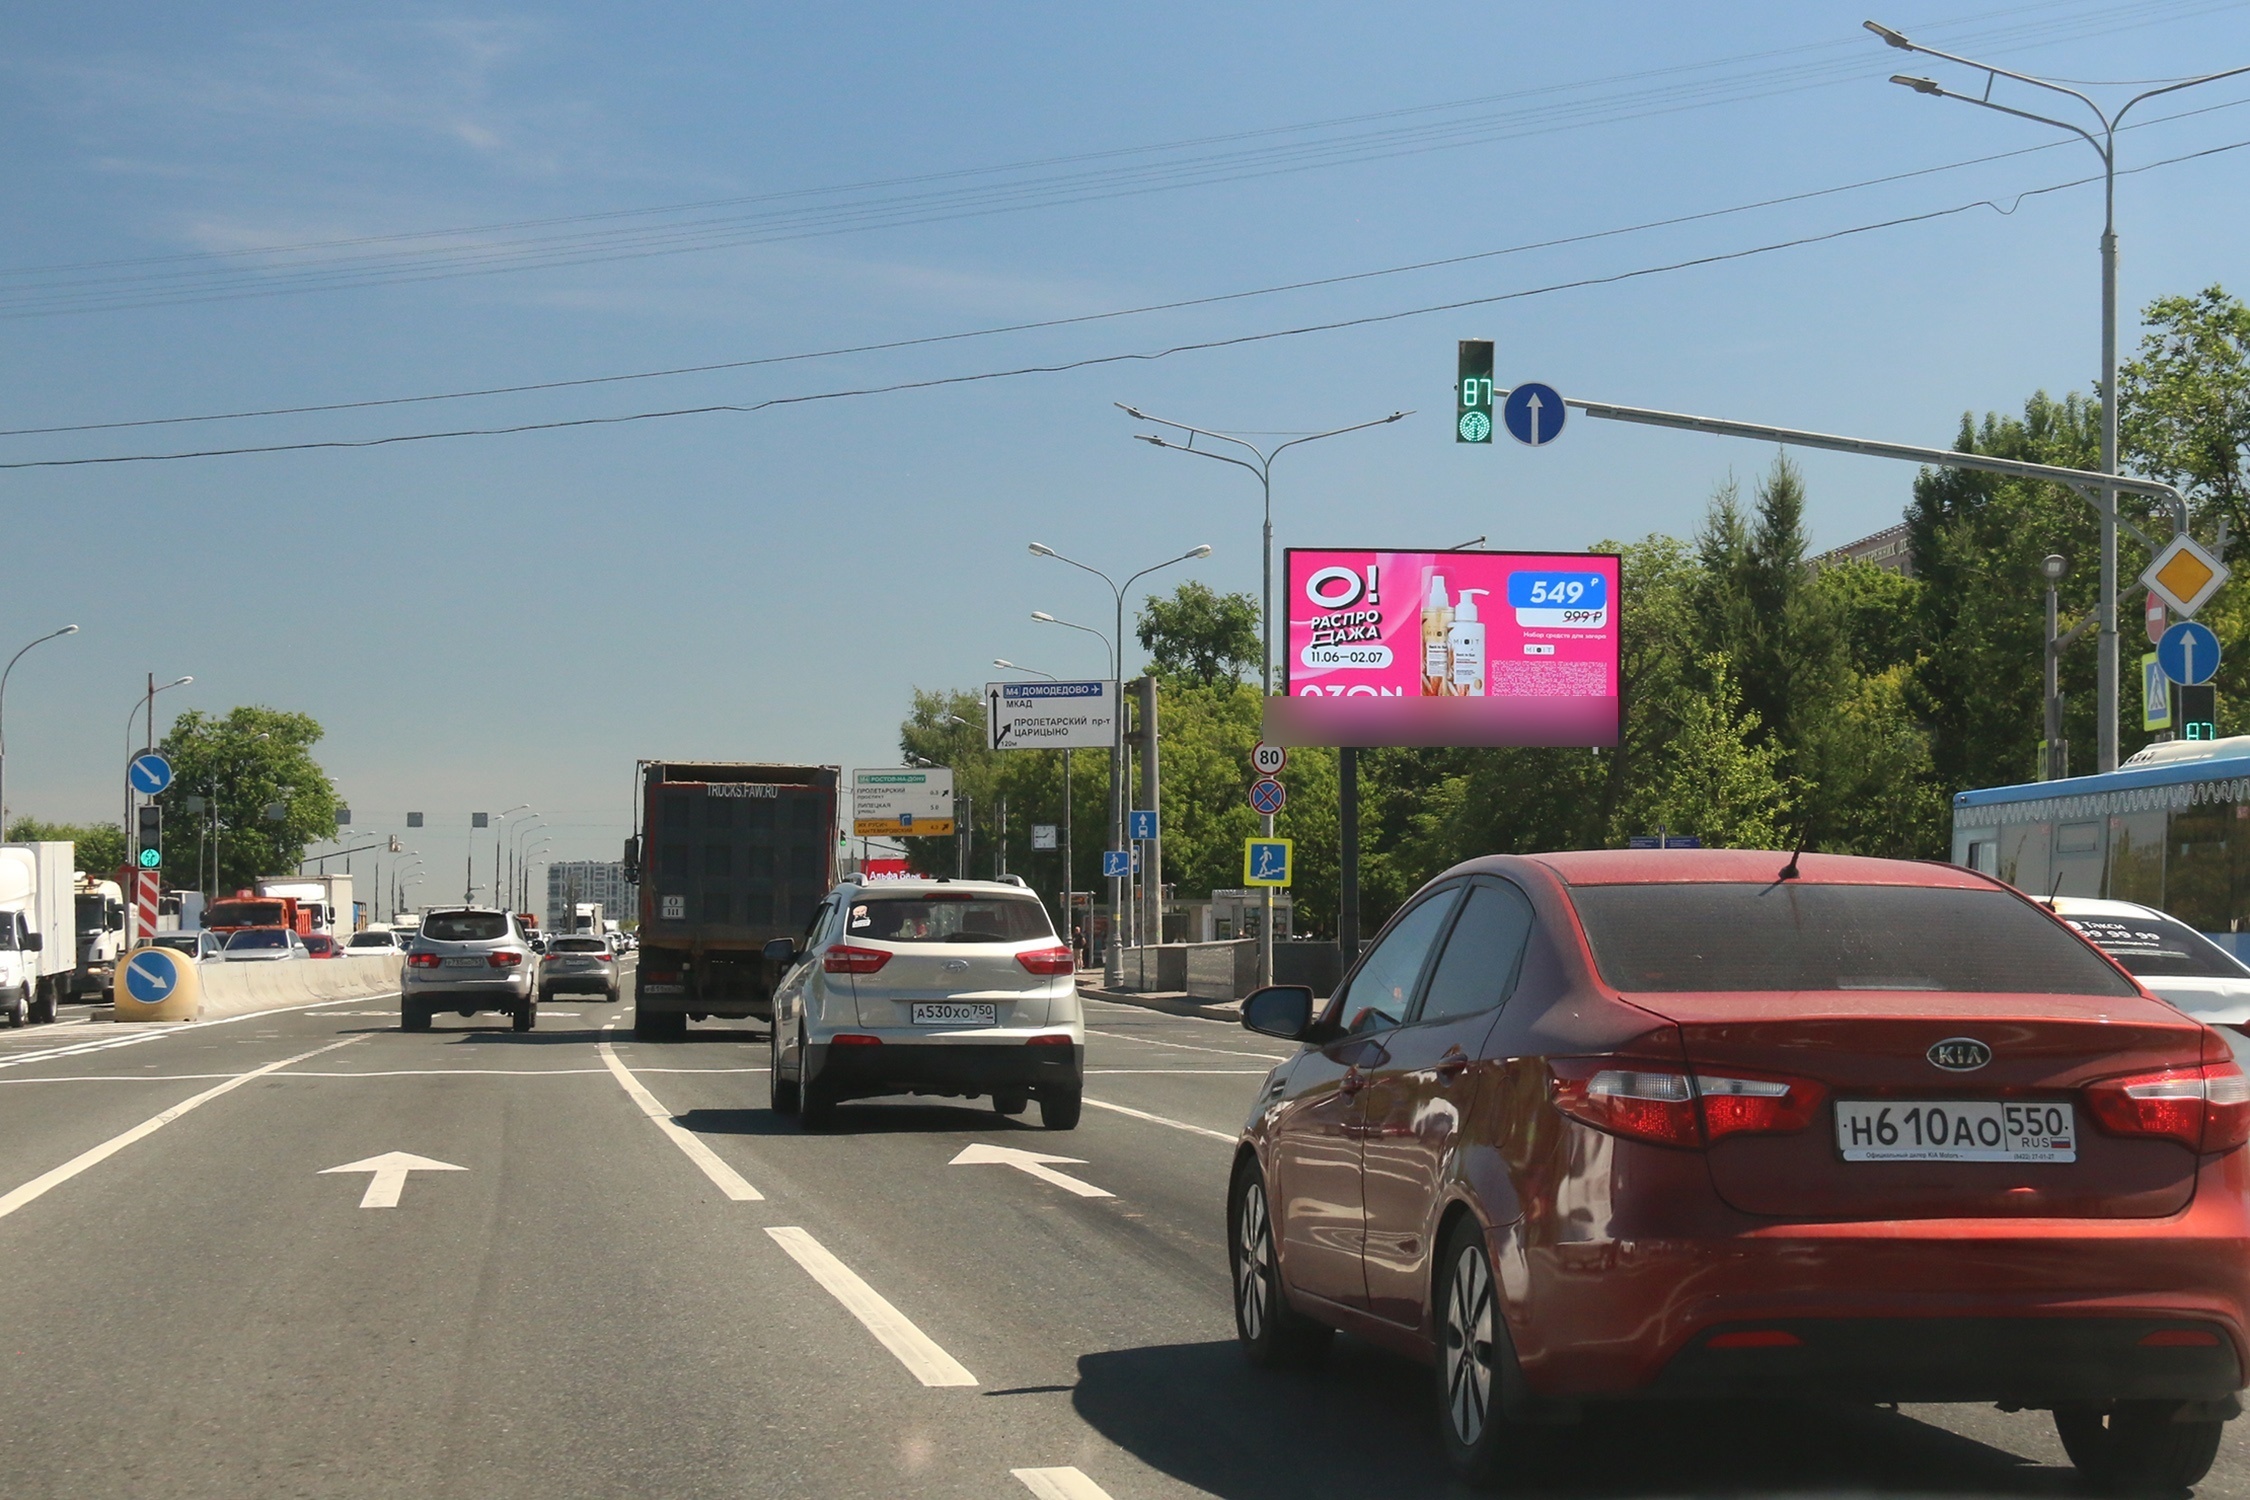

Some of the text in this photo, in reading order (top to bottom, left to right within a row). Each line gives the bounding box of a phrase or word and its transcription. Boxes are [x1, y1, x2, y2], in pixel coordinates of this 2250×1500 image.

[1464, 378, 1491, 406] 87
[1306, 565, 1379, 610] О!
[1530, 581, 1584, 604] 549
[1310, 610, 1381, 631] РАСПРО
[1563, 610, 1590, 623] 999
[1310, 625, 1381, 648] ДАЖА
[1006, 686, 1089, 696] М4 ДОМОДЕДОВО
[1006, 699, 1033, 708] МКАД
[1014, 716, 1111, 726] ПРОЛЕТАРСКИЙ пр-т
[1014, 728, 1069, 737] ЦАРИЦЫНО
[1260, 750, 1279, 765] 80
[707, 785, 778, 798] TRUCKS.FAW.RU
[2106, 930, 2132, 939] 99
[2135, 931, 2160, 940] 99
[917, 1005, 992, 1018] А530ХО 750
[1938, 1045, 1983, 1065] KIA
[1851, 1107, 2063, 1146] Н610АО 550
[2021, 1137, 2050, 1148] RUS
